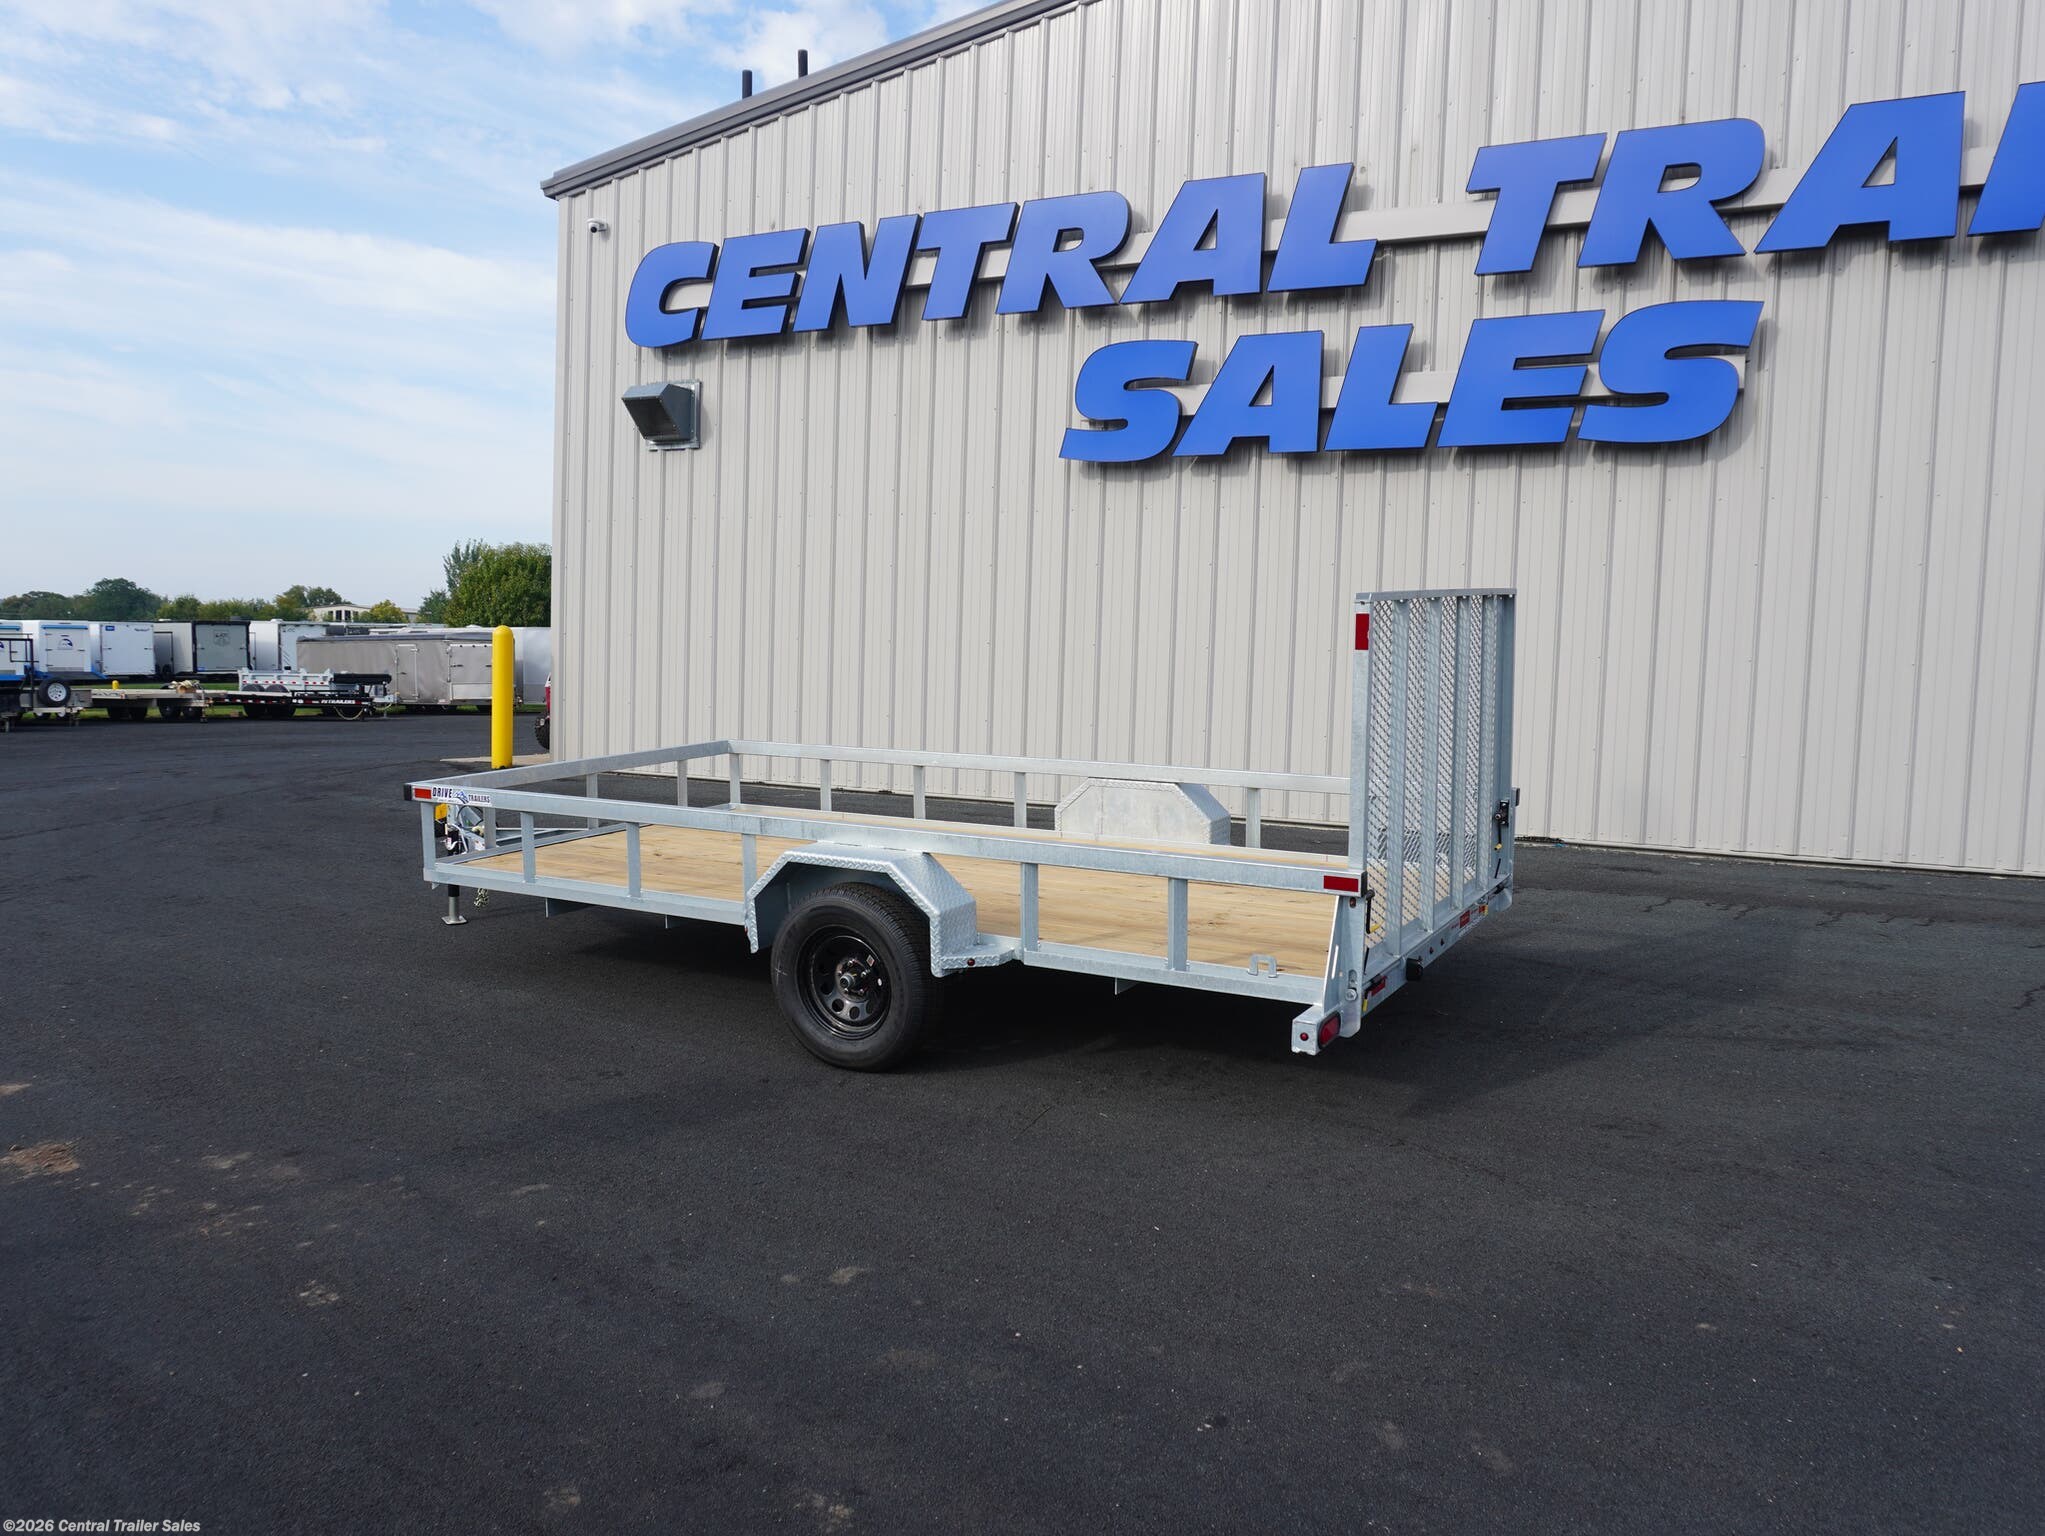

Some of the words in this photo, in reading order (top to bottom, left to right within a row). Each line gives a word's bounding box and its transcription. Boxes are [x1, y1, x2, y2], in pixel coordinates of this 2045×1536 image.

[625, 163, 1378, 348] CENTRAL
[1059, 300, 1765, 462] SALES
[432, 787, 453, 798] DRIVE
[468, 794, 490, 803] TRAILERS
